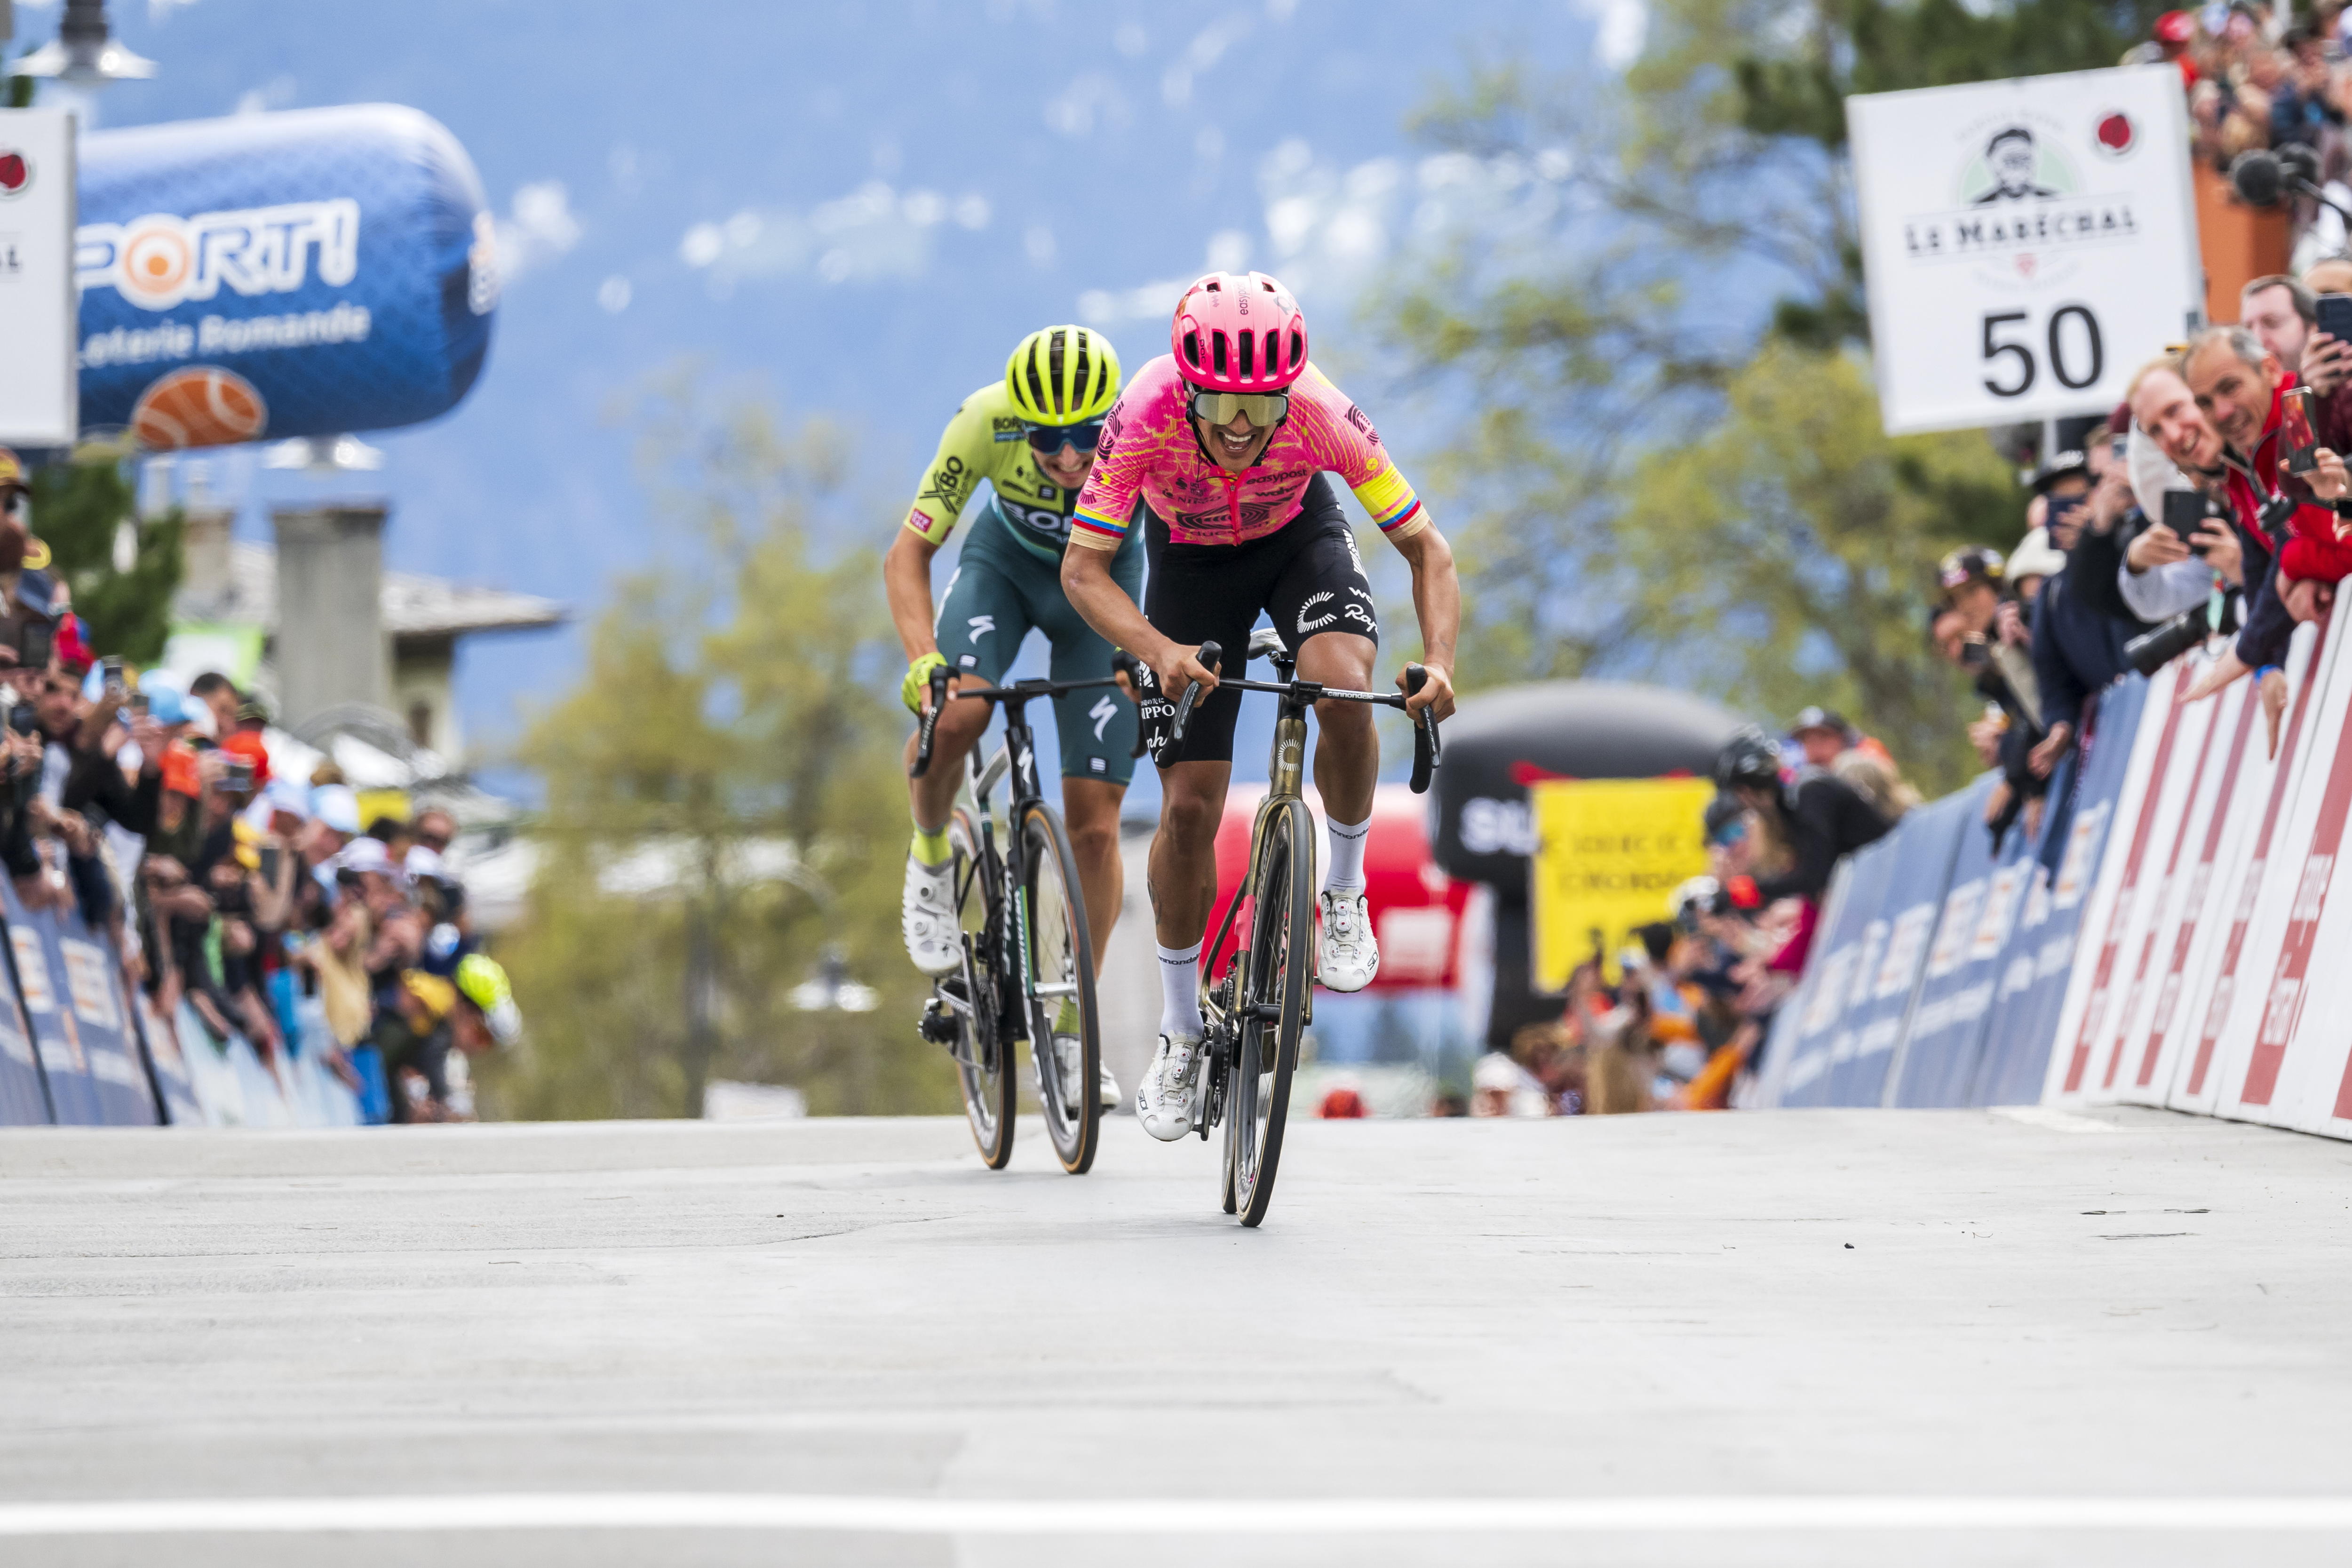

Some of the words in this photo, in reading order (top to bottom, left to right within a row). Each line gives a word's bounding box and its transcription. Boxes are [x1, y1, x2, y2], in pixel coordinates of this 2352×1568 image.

[78, 318, 194, 370] oterie
[1983, 303, 2103, 398] 50
[919, 456, 963, 516] XBO
[1246, 469, 1308, 485] easypost
[1327, 691, 1374, 700] cannondale
